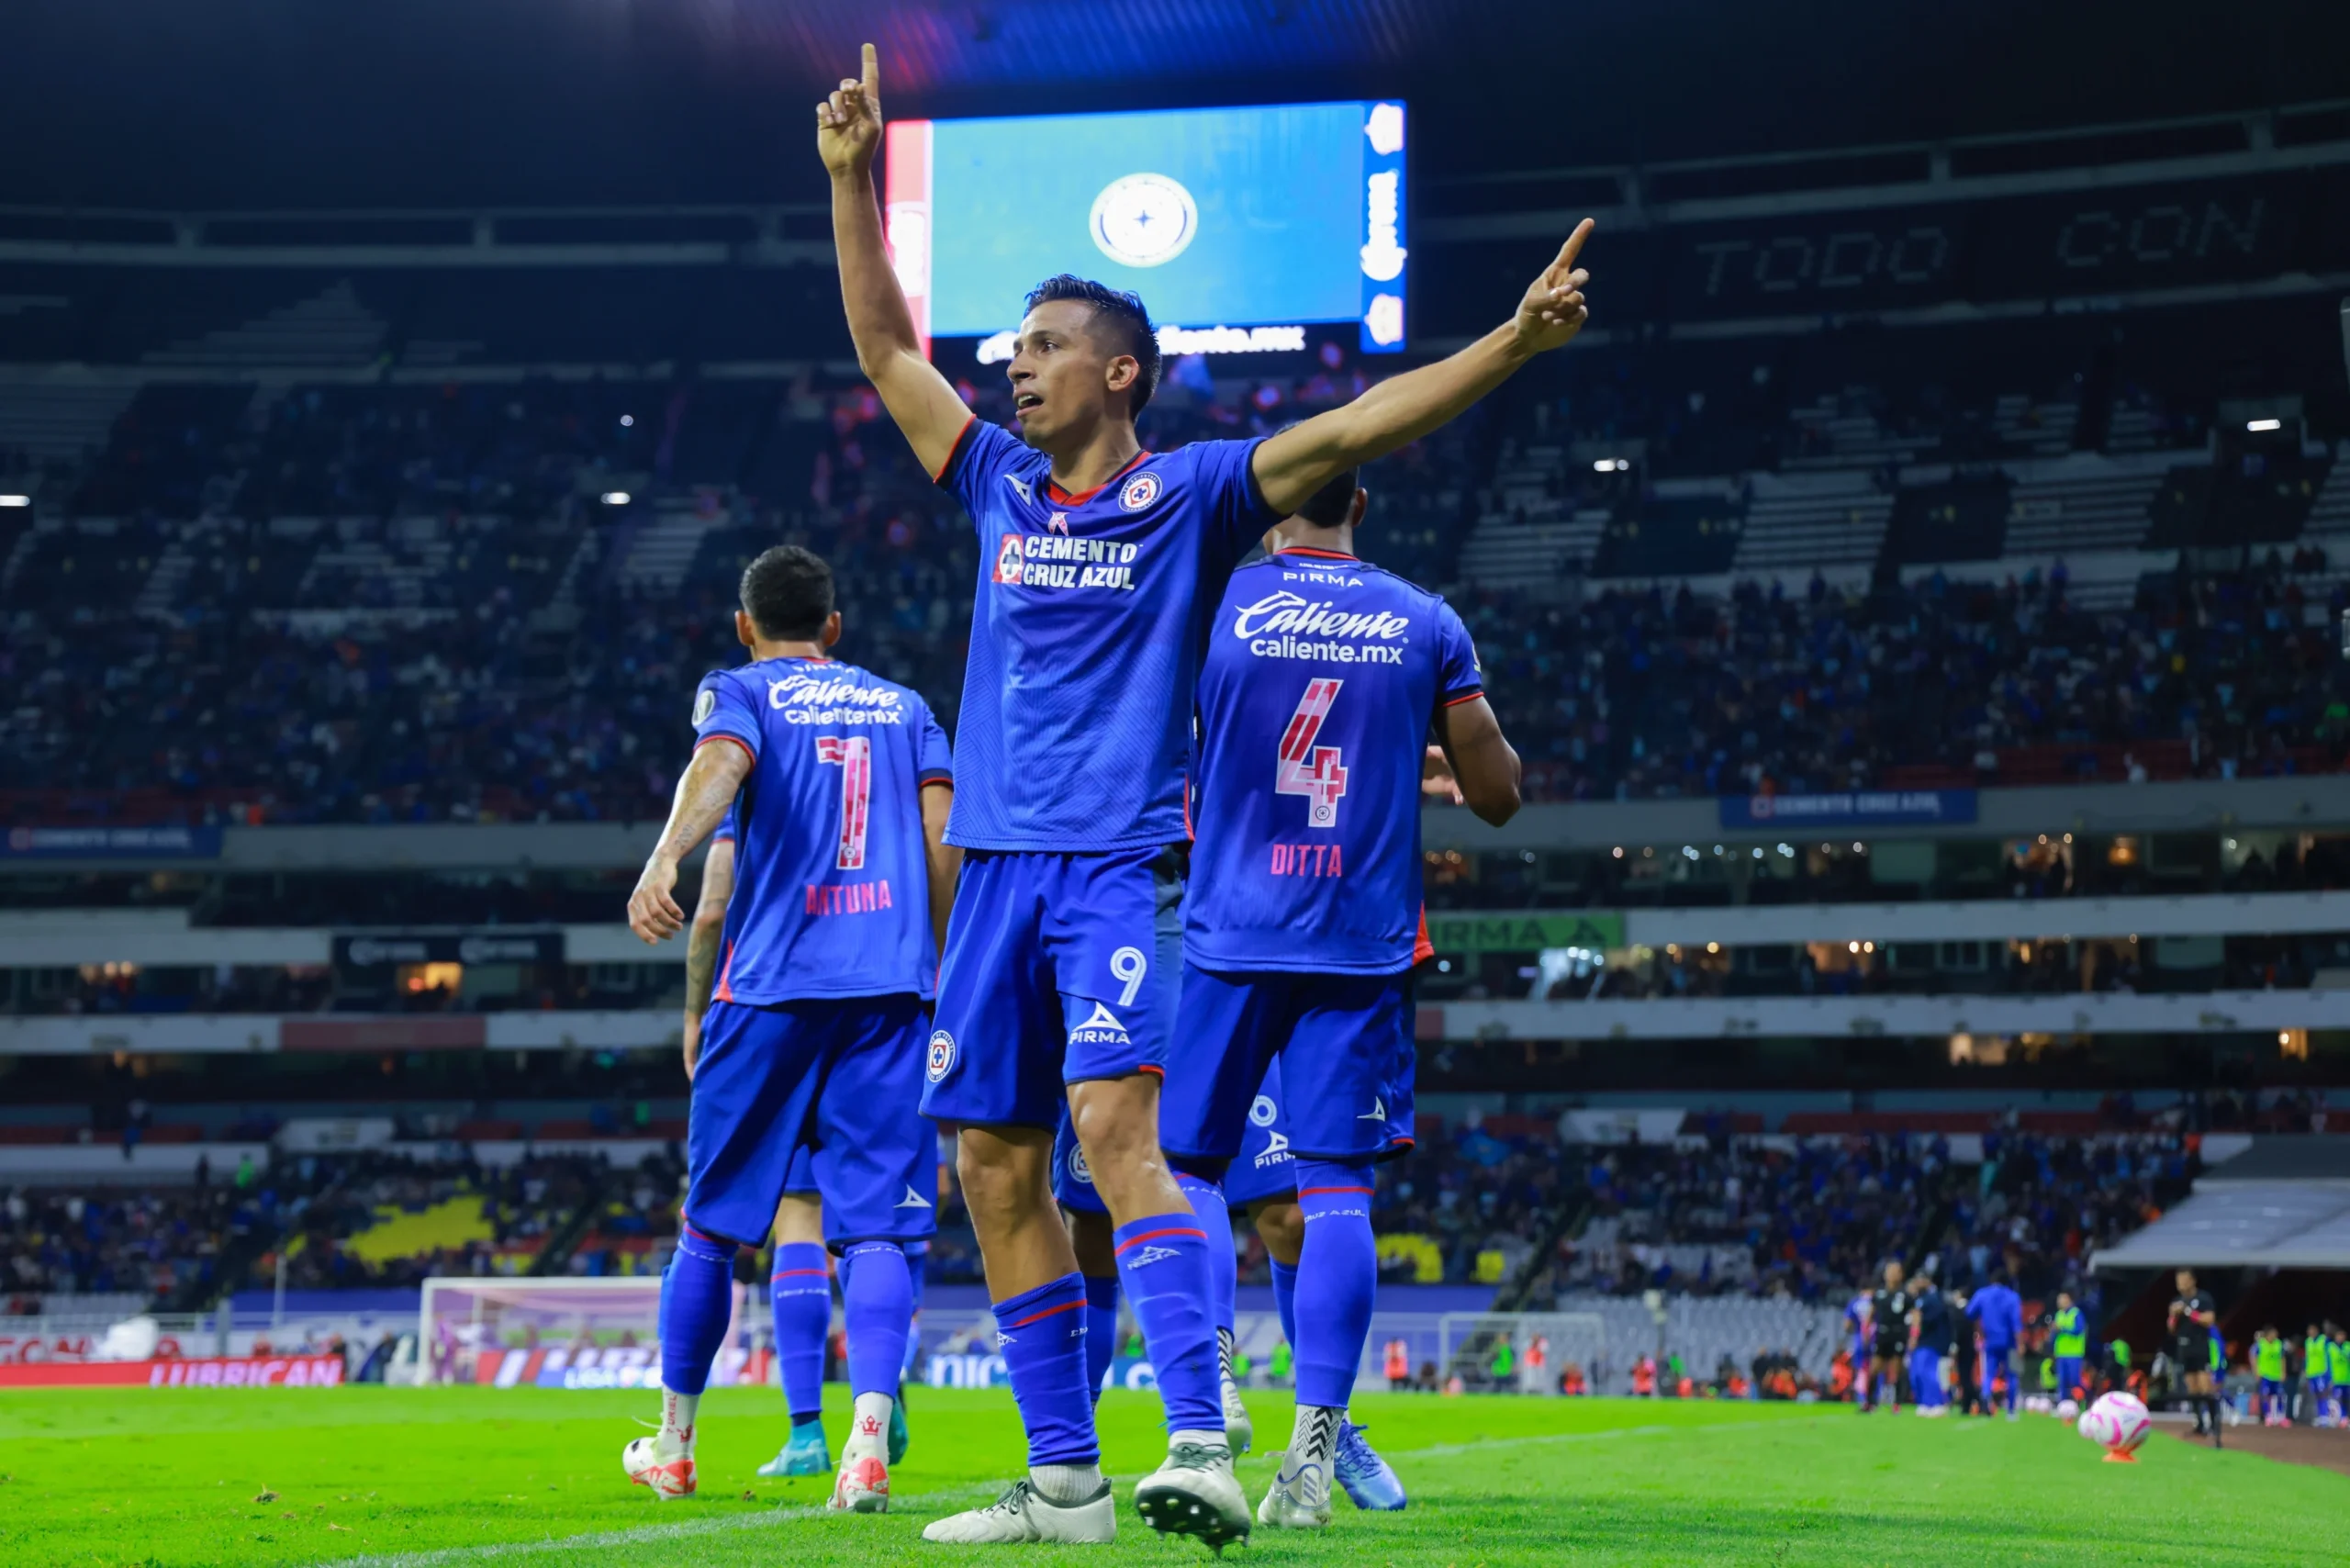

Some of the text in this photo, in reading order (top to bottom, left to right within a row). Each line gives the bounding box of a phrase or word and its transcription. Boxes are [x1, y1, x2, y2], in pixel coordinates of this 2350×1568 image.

[1695, 198, 2267, 297] TODO CON
[1024, 536, 1137, 564] CEMENTO
[1024, 563, 1135, 589] CRUZ AZUL
[1283, 572, 1363, 587] PIRMA
[1234, 589, 1409, 639] Caliente
[1250, 635, 1404, 665] caliente.mx
[767, 675, 900, 710] Caliente
[784, 705, 901, 725] calientemx
[1275, 678, 1348, 827] 4
[1270, 844, 1342, 878] DITTA
[1110, 946, 1147, 1006] 9
[1069, 1030, 1132, 1045] PIRMA
